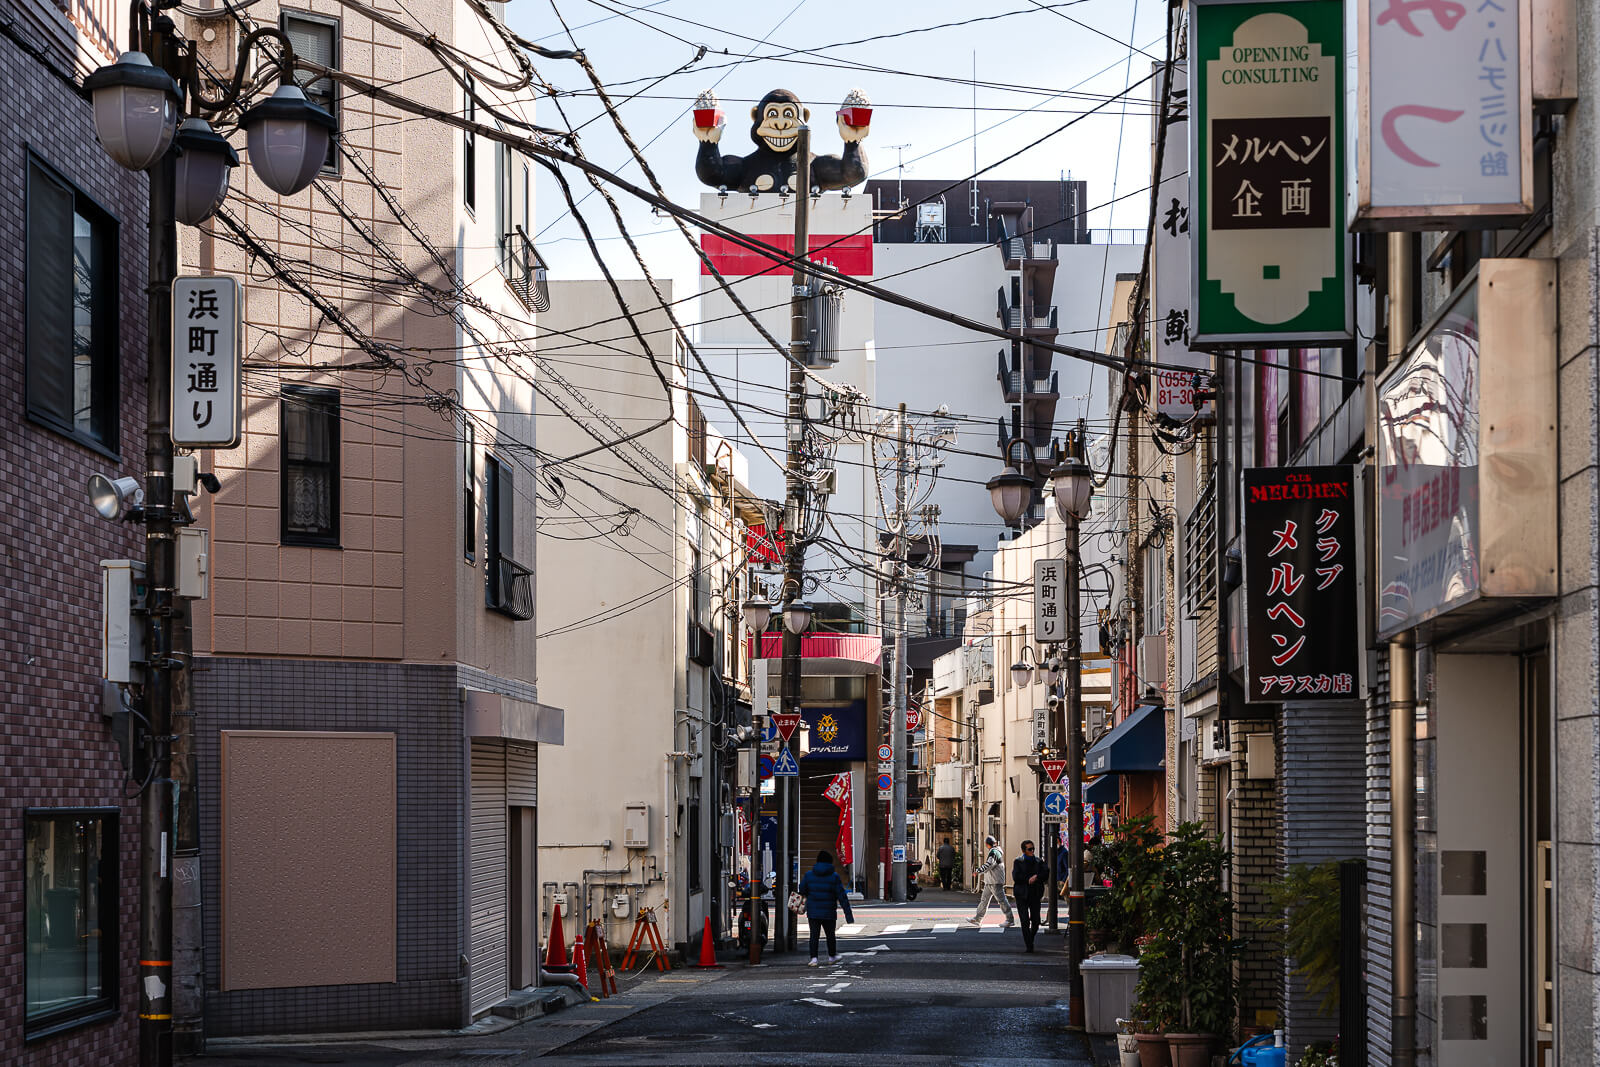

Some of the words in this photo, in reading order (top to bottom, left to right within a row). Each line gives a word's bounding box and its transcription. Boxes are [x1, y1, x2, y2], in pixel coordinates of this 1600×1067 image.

[1232, 45, 1309, 63] OPENNING
[1221, 67, 1319, 85] CONSULTING
[1216, 134, 1327, 168] メルヘン
[187, 288, 219, 430] 浜町通り
[1158, 370, 1195, 388] (0557
[1158, 389, 1209, 405] 81-30
[1249, 482, 1349, 504] MELUHEN
[1315, 508, 1344, 591] クラブ
[1041, 566, 1058, 635] 浜町通り
[1266, 519, 1306, 667] メルヘン
[1259, 673, 1353, 695] アラスカ店
[879, 748, 890, 757] 30
